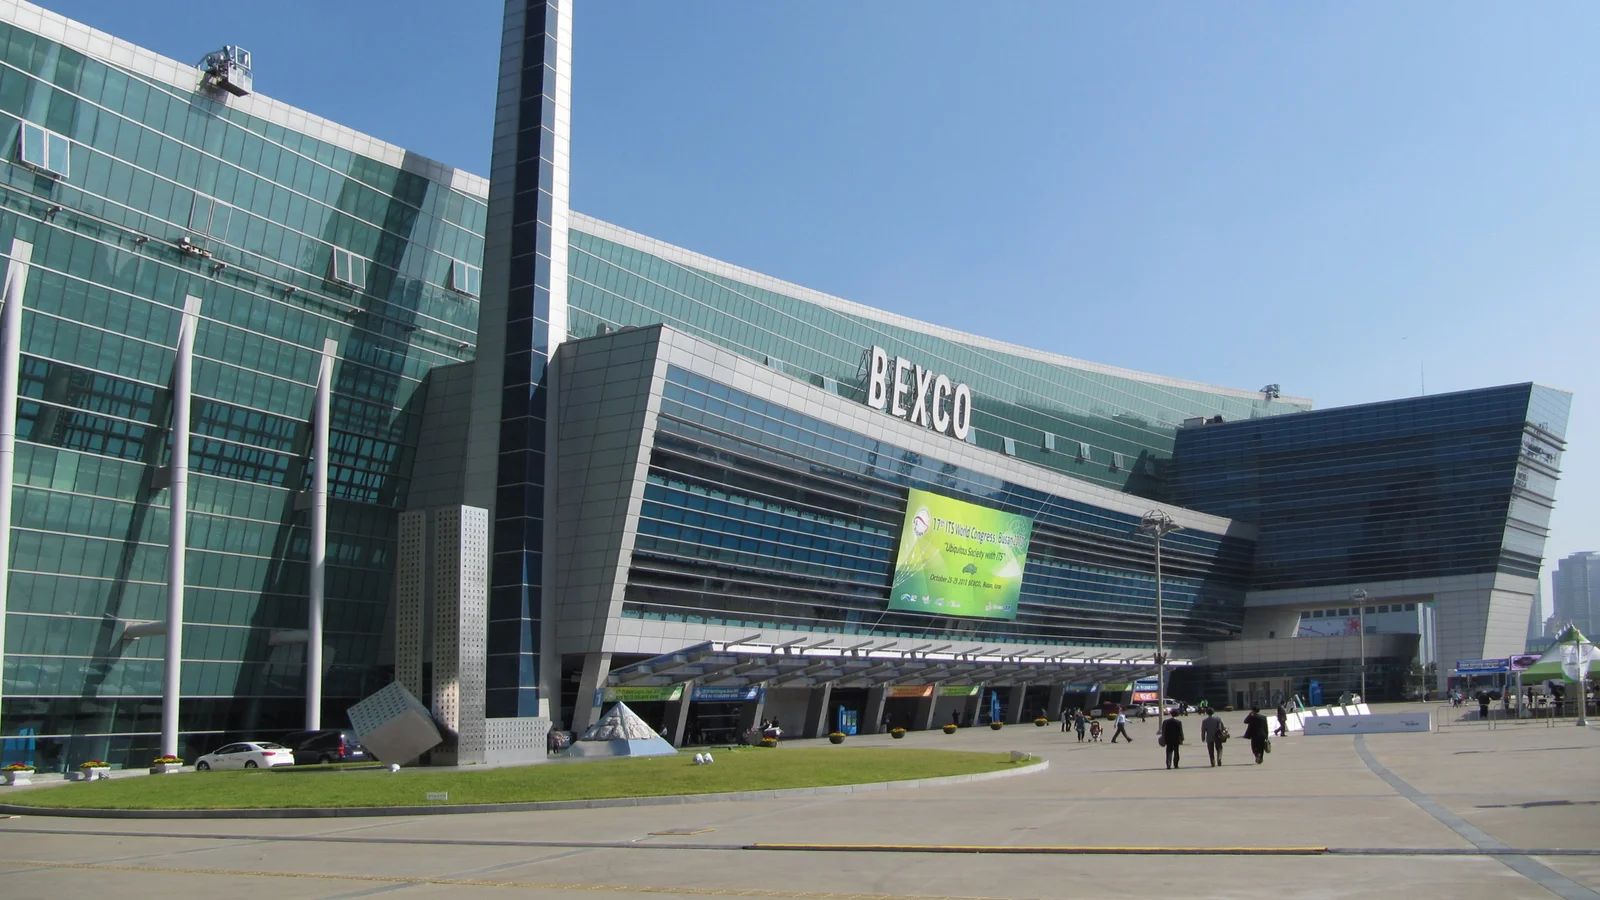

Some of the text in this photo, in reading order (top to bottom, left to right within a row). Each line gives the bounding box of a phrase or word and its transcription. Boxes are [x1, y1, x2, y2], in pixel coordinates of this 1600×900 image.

[868, 345, 971, 440] BEXCO
[945, 521, 955, 535] ITS
[955, 523, 971, 538] World
[970, 527, 997, 544] Congress,
[998, 532, 1013, 545] Busan
[967, 547, 985, 560] Society
[985, 551, 996, 560] with
[929, 573, 948, 583] October
